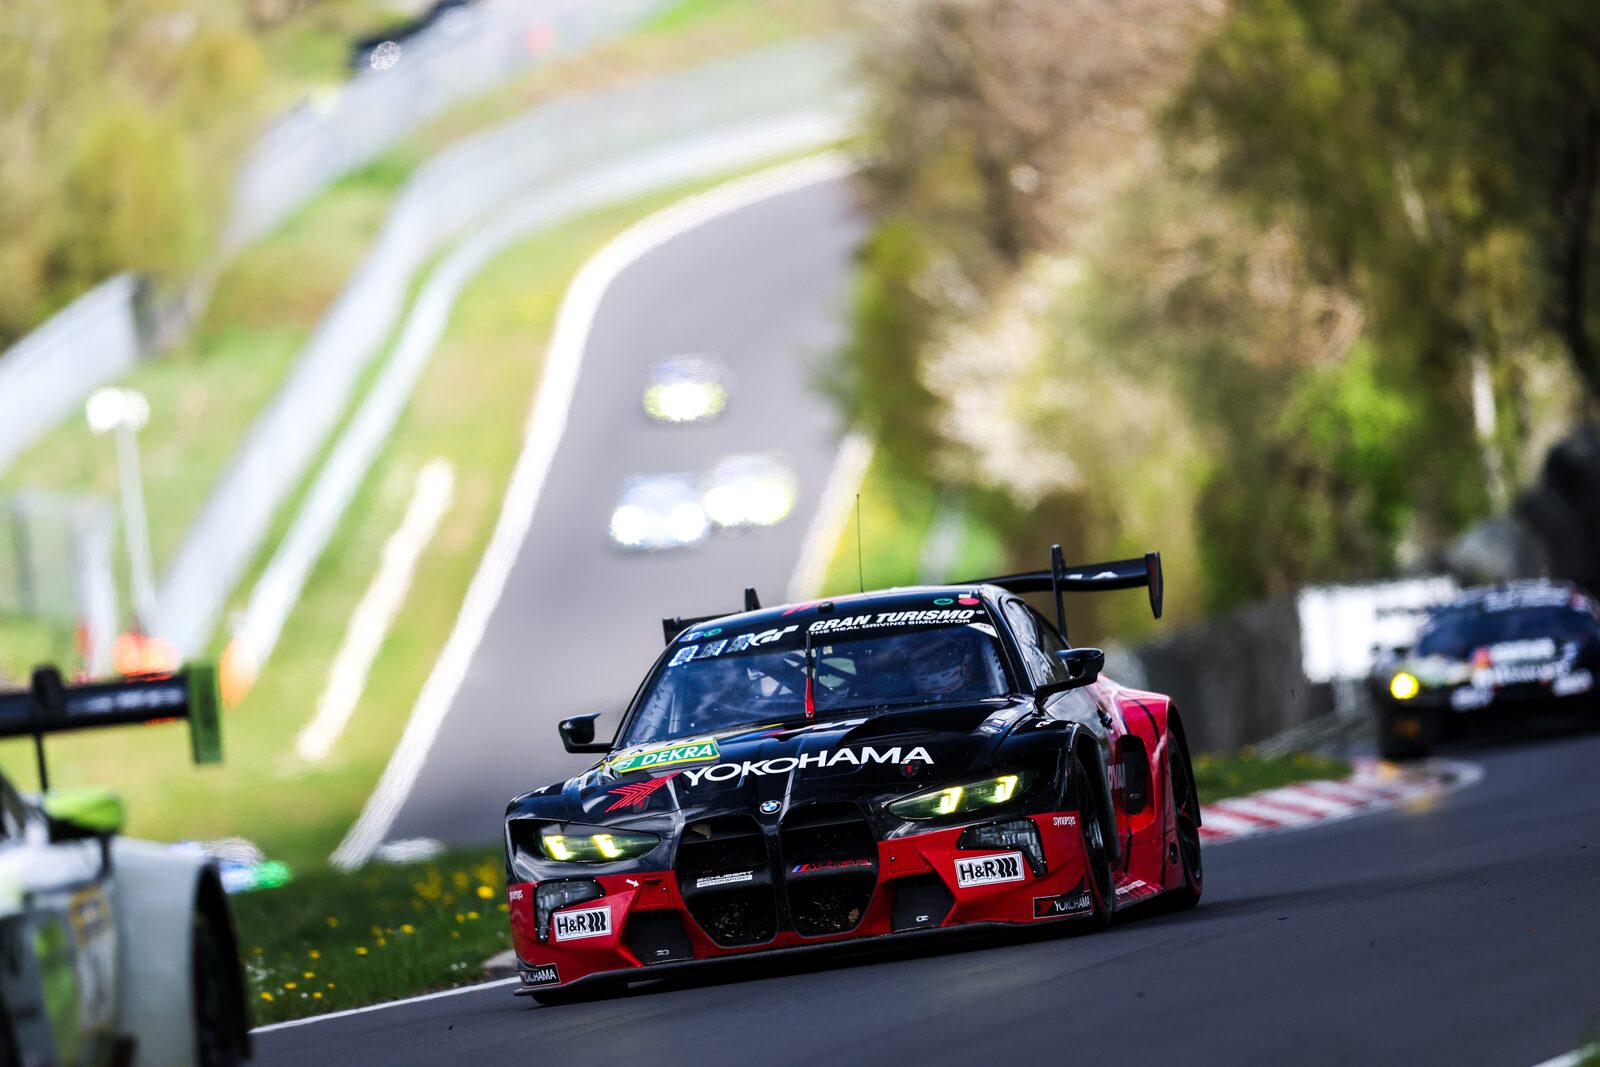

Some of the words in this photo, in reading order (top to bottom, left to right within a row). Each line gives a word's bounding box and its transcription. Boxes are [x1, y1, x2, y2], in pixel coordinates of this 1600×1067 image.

[809, 615, 871, 631] GRAN
[832, 625, 860, 633] REAL
[862, 621, 906, 629] DRIVING
[641, 745, 712, 766] DEKRA
[683, 746, 935, 787] YOKOHAMA
[696, 870, 754, 883] SCHUBERT
[959, 861, 997, 882] H&R
[697, 876, 752, 888] MOTORSPORT
[1054, 896, 1090, 911] YOKOHAMA
[557, 915, 587, 934] H&R
